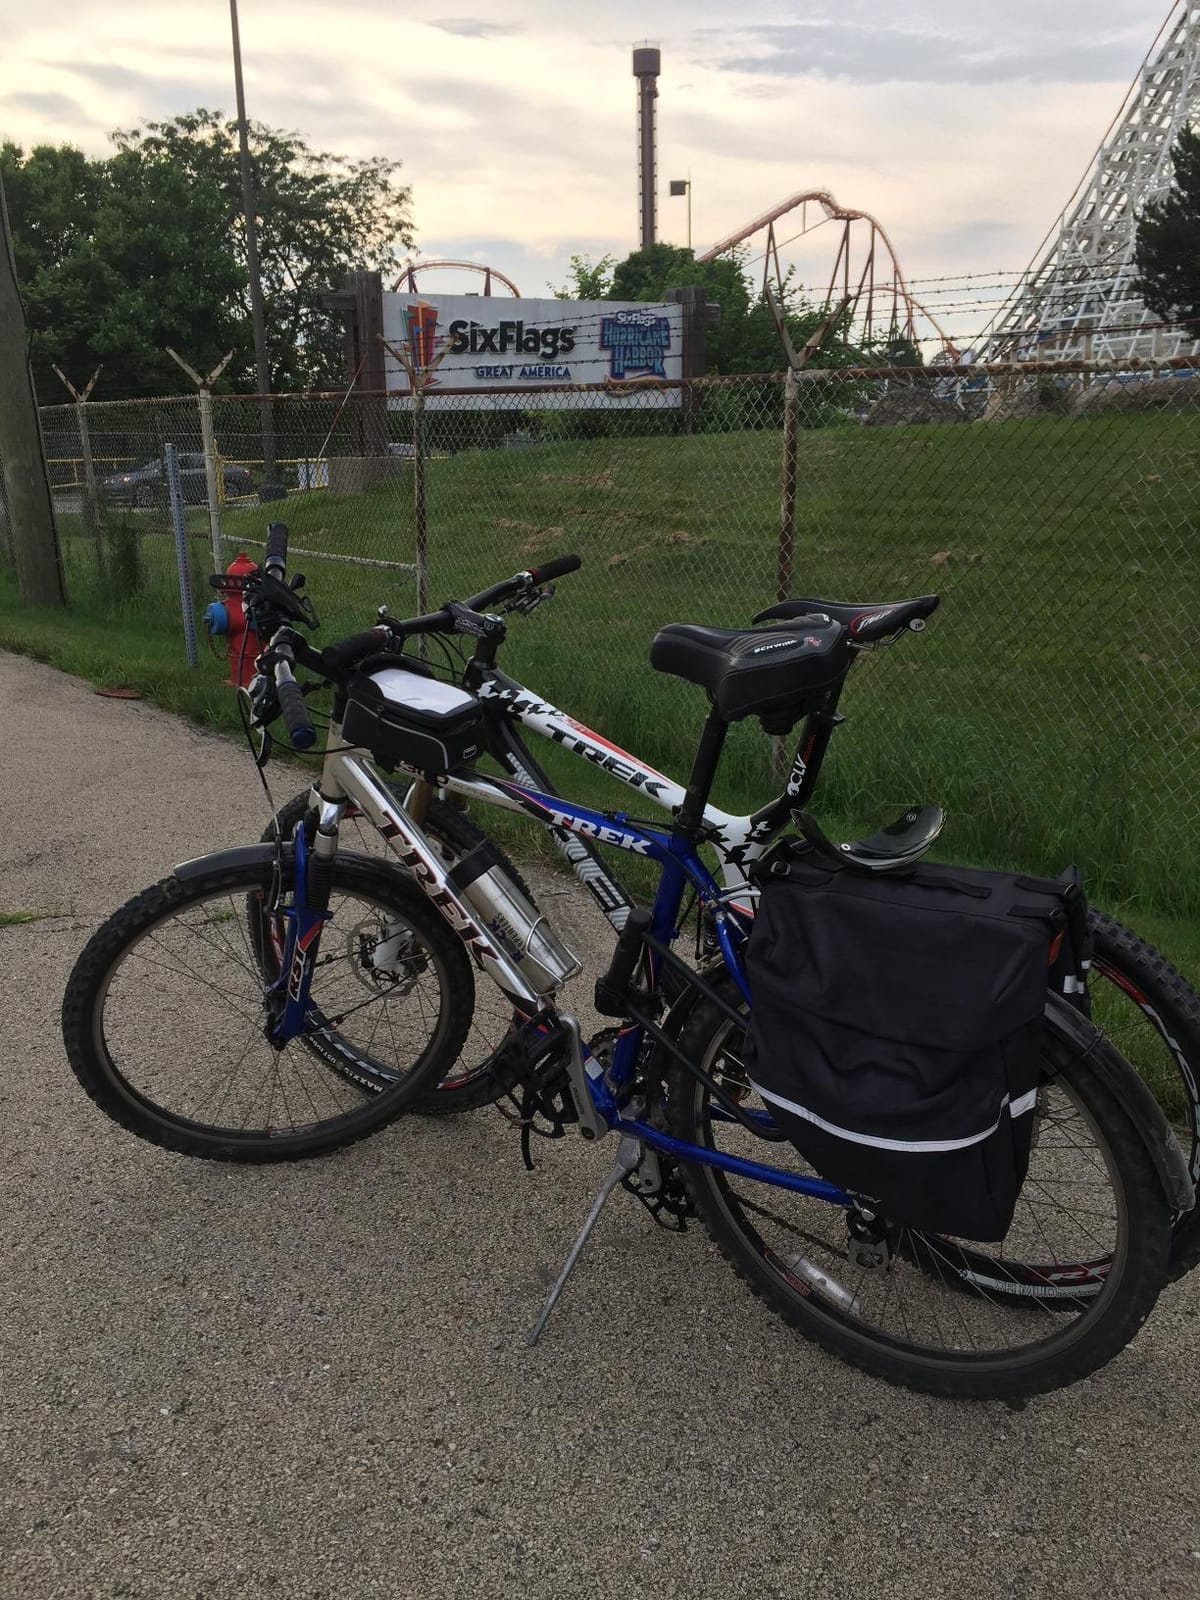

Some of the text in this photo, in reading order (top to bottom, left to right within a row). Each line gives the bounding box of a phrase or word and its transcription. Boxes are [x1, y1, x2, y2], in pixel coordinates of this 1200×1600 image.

[603, 320, 669, 346] HURRICANE
[475, 365, 571, 378] GREAT AMERICA
[614, 345, 663, 373] HARBOR
[547, 723, 671, 799] TREK
[548, 808, 652, 855] TREK
[376, 809, 500, 970] TREK
